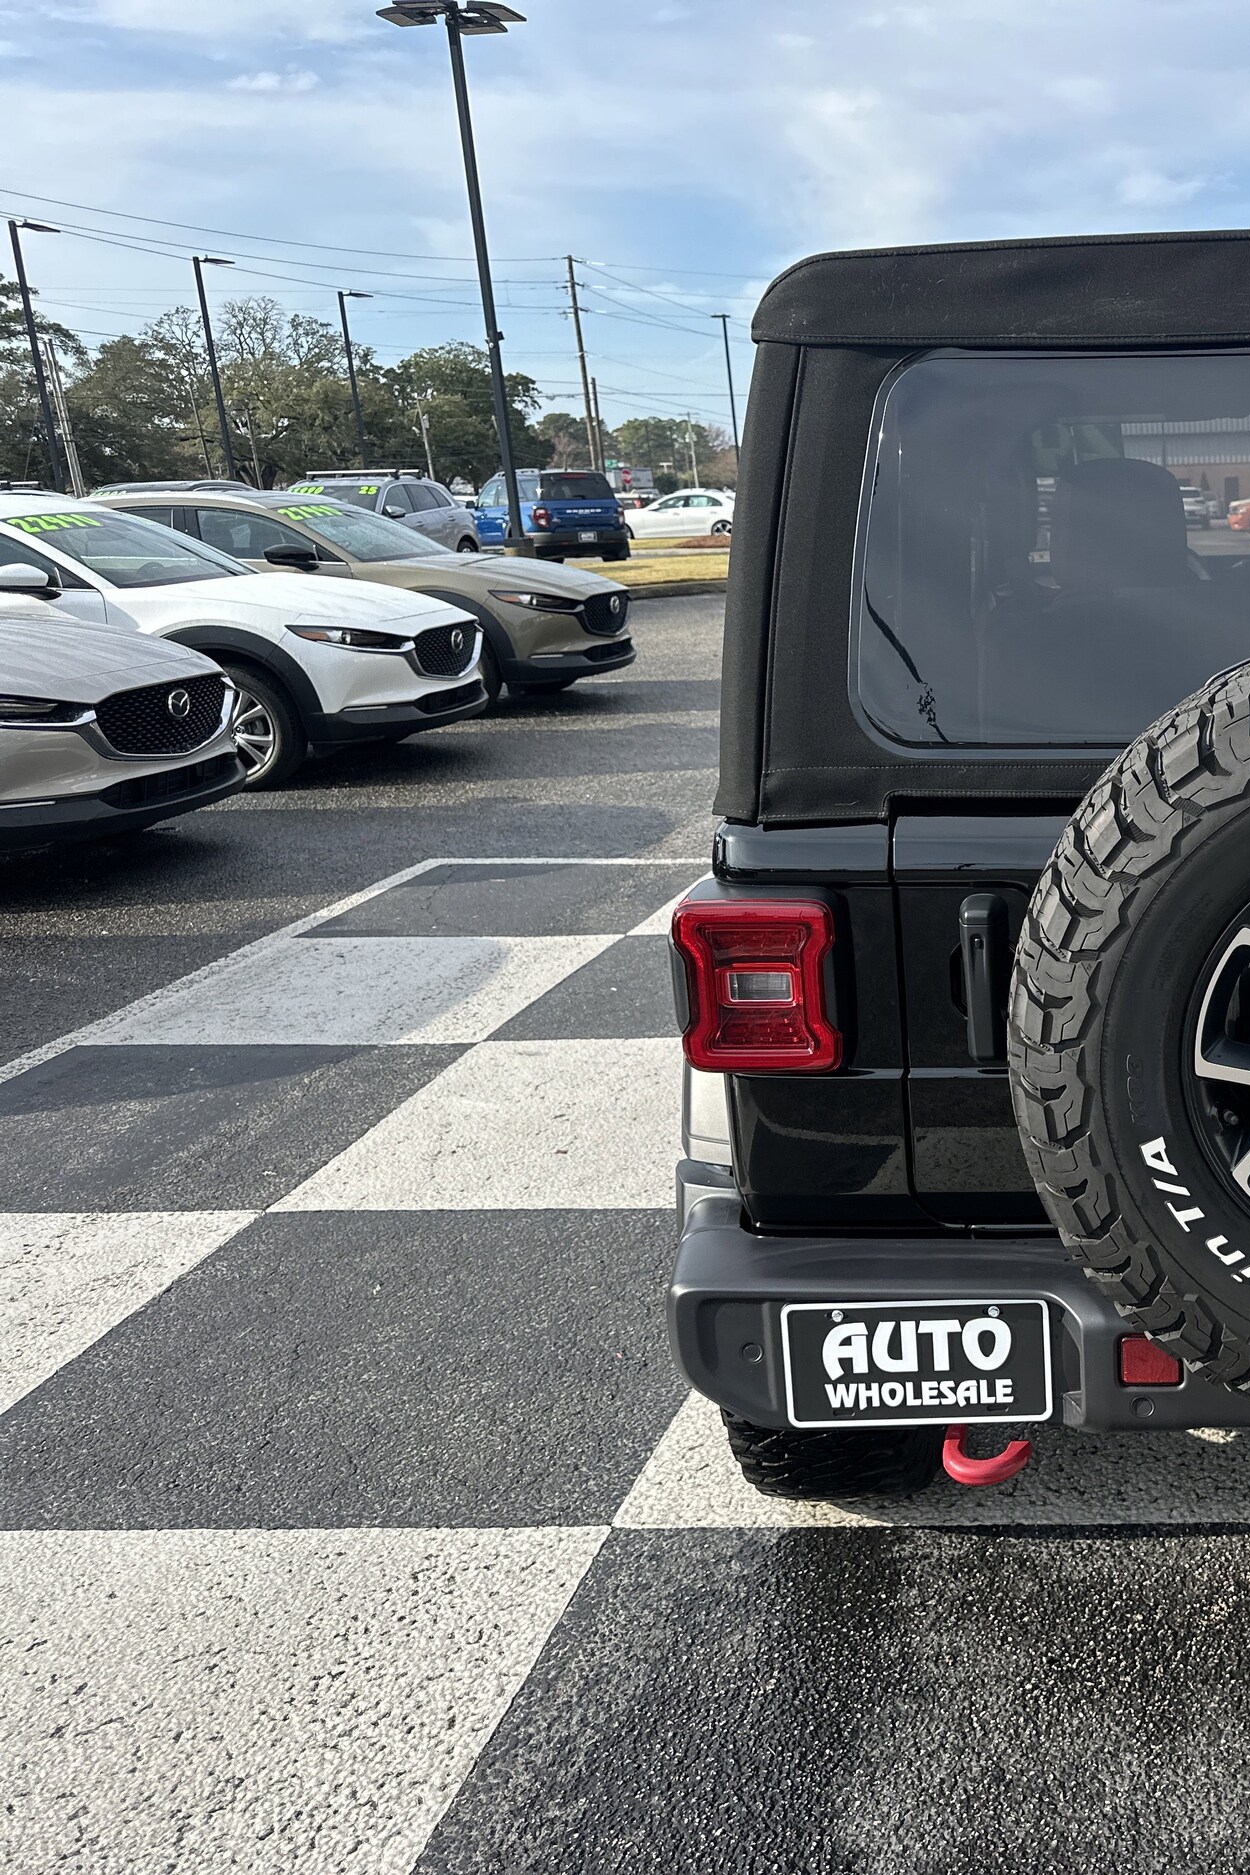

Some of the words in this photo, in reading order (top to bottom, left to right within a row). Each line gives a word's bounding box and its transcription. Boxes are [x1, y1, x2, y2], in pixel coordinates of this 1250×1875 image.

[358, 486, 379, 496] 25
[6, 513, 104, 534] 22990
[1141, 1137, 1205, 1233] T/A
[823, 1318, 1011, 1380] AUTO
[825, 1379, 1014, 1410] WHOLESALE
